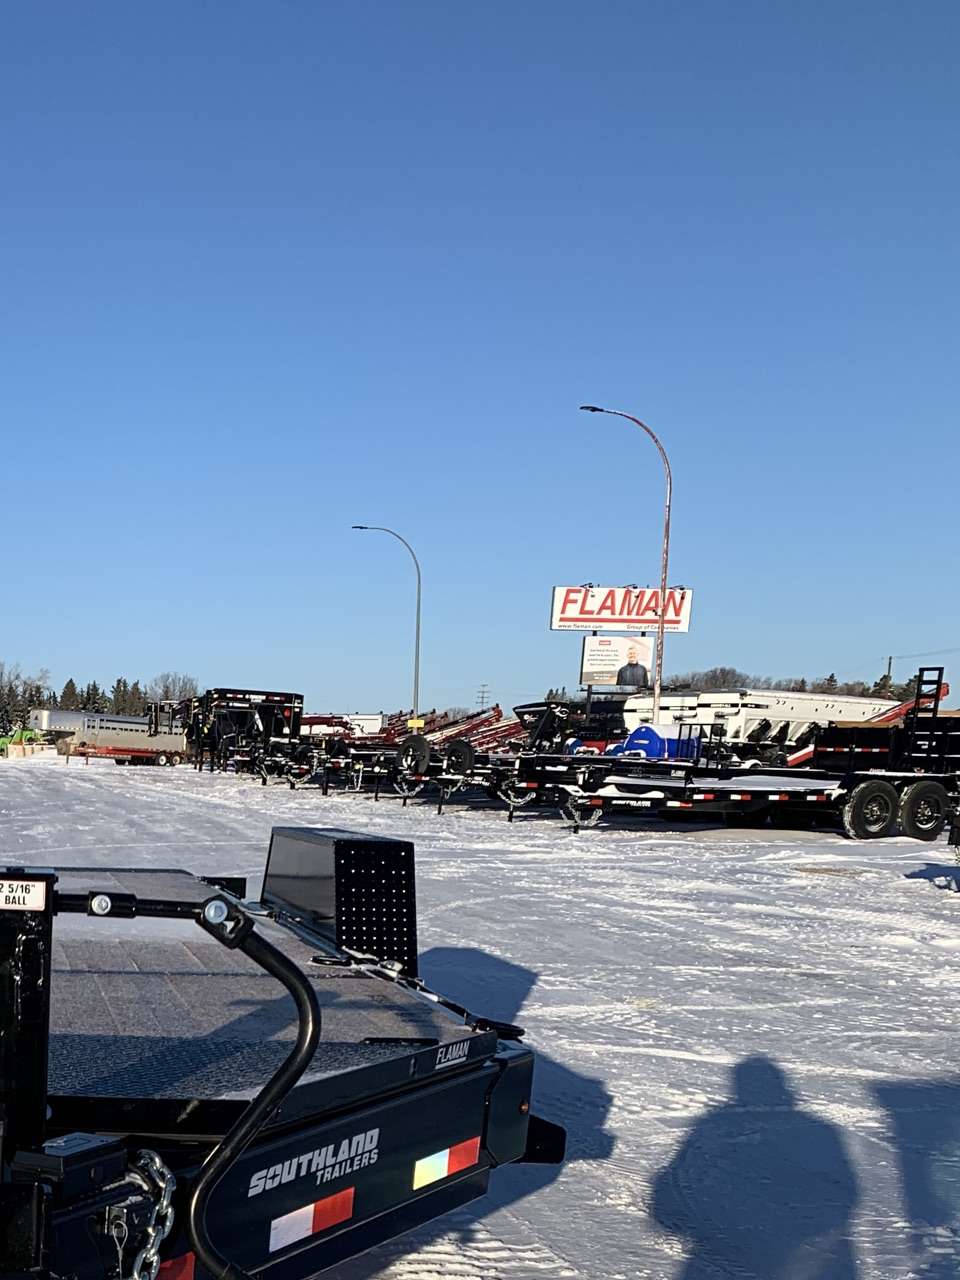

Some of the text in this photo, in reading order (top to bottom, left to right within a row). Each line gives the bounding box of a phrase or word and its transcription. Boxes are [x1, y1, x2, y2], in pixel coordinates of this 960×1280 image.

[560, 588, 687, 617] FLAMAN
[5, 895, 27, 906] BALL
[8, 884, 36, 894] 5/16"
[436, 1040, 470, 1065] FLAMAN
[248, 1128, 380, 1197] SOUTHLAND
[316, 1148, 379, 1186] TRAILERS
